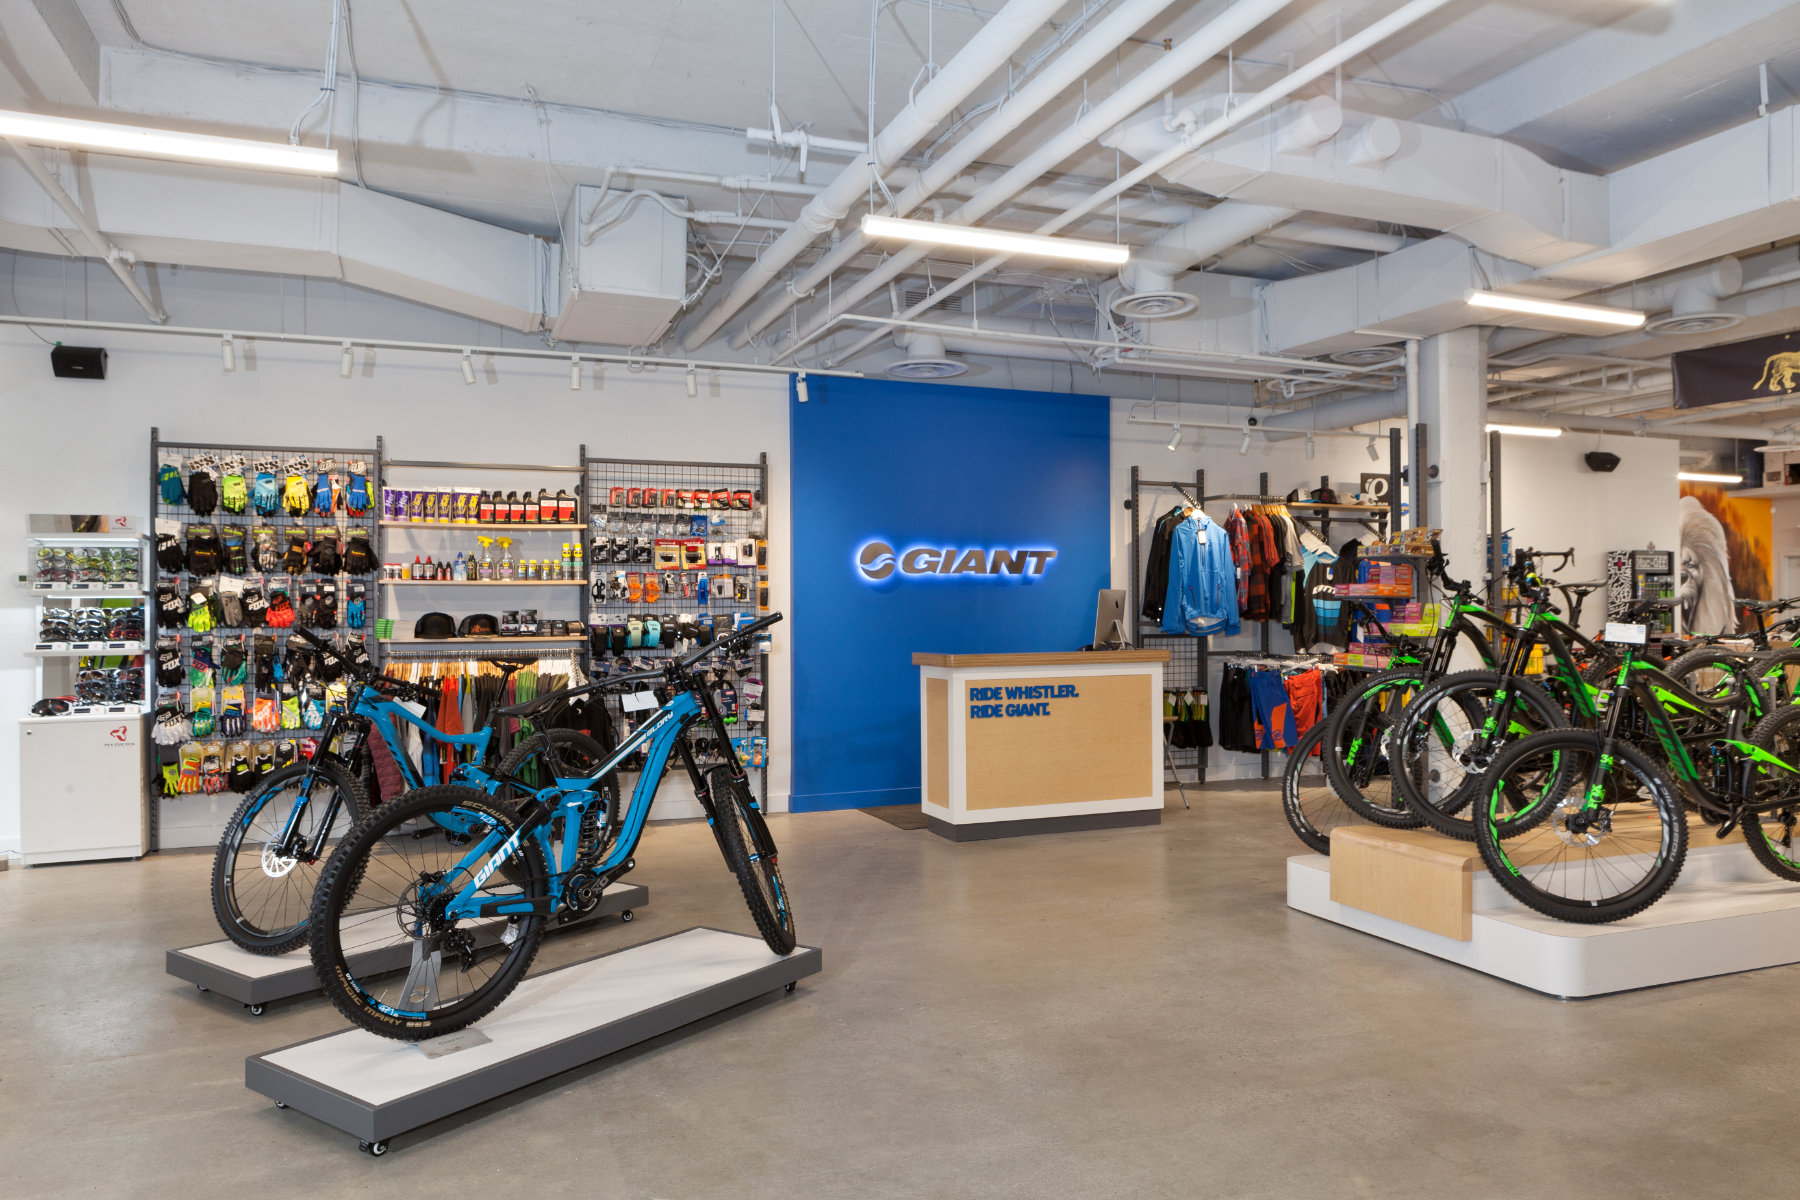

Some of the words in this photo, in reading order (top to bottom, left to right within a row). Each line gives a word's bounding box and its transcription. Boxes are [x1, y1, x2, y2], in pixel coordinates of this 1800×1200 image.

[902, 549, 1058, 574] GIANT
[163, 597, 180, 610] FOX
[248, 600, 265, 611] FOX
[162, 657, 180, 670] FOX
[970, 687, 1002, 701] RIDE
[1005, 685, 1079, 700] WHISTLER.
[970, 704, 1002, 719] RIDE
[1006, 702, 1050, 717] GIANT.
[647, 711, 674, 737] GLORY
[473, 829, 519, 889] GIANT
[335, 965, 363, 1006] MAGIC
[364, 1005, 402, 1026] MARY
